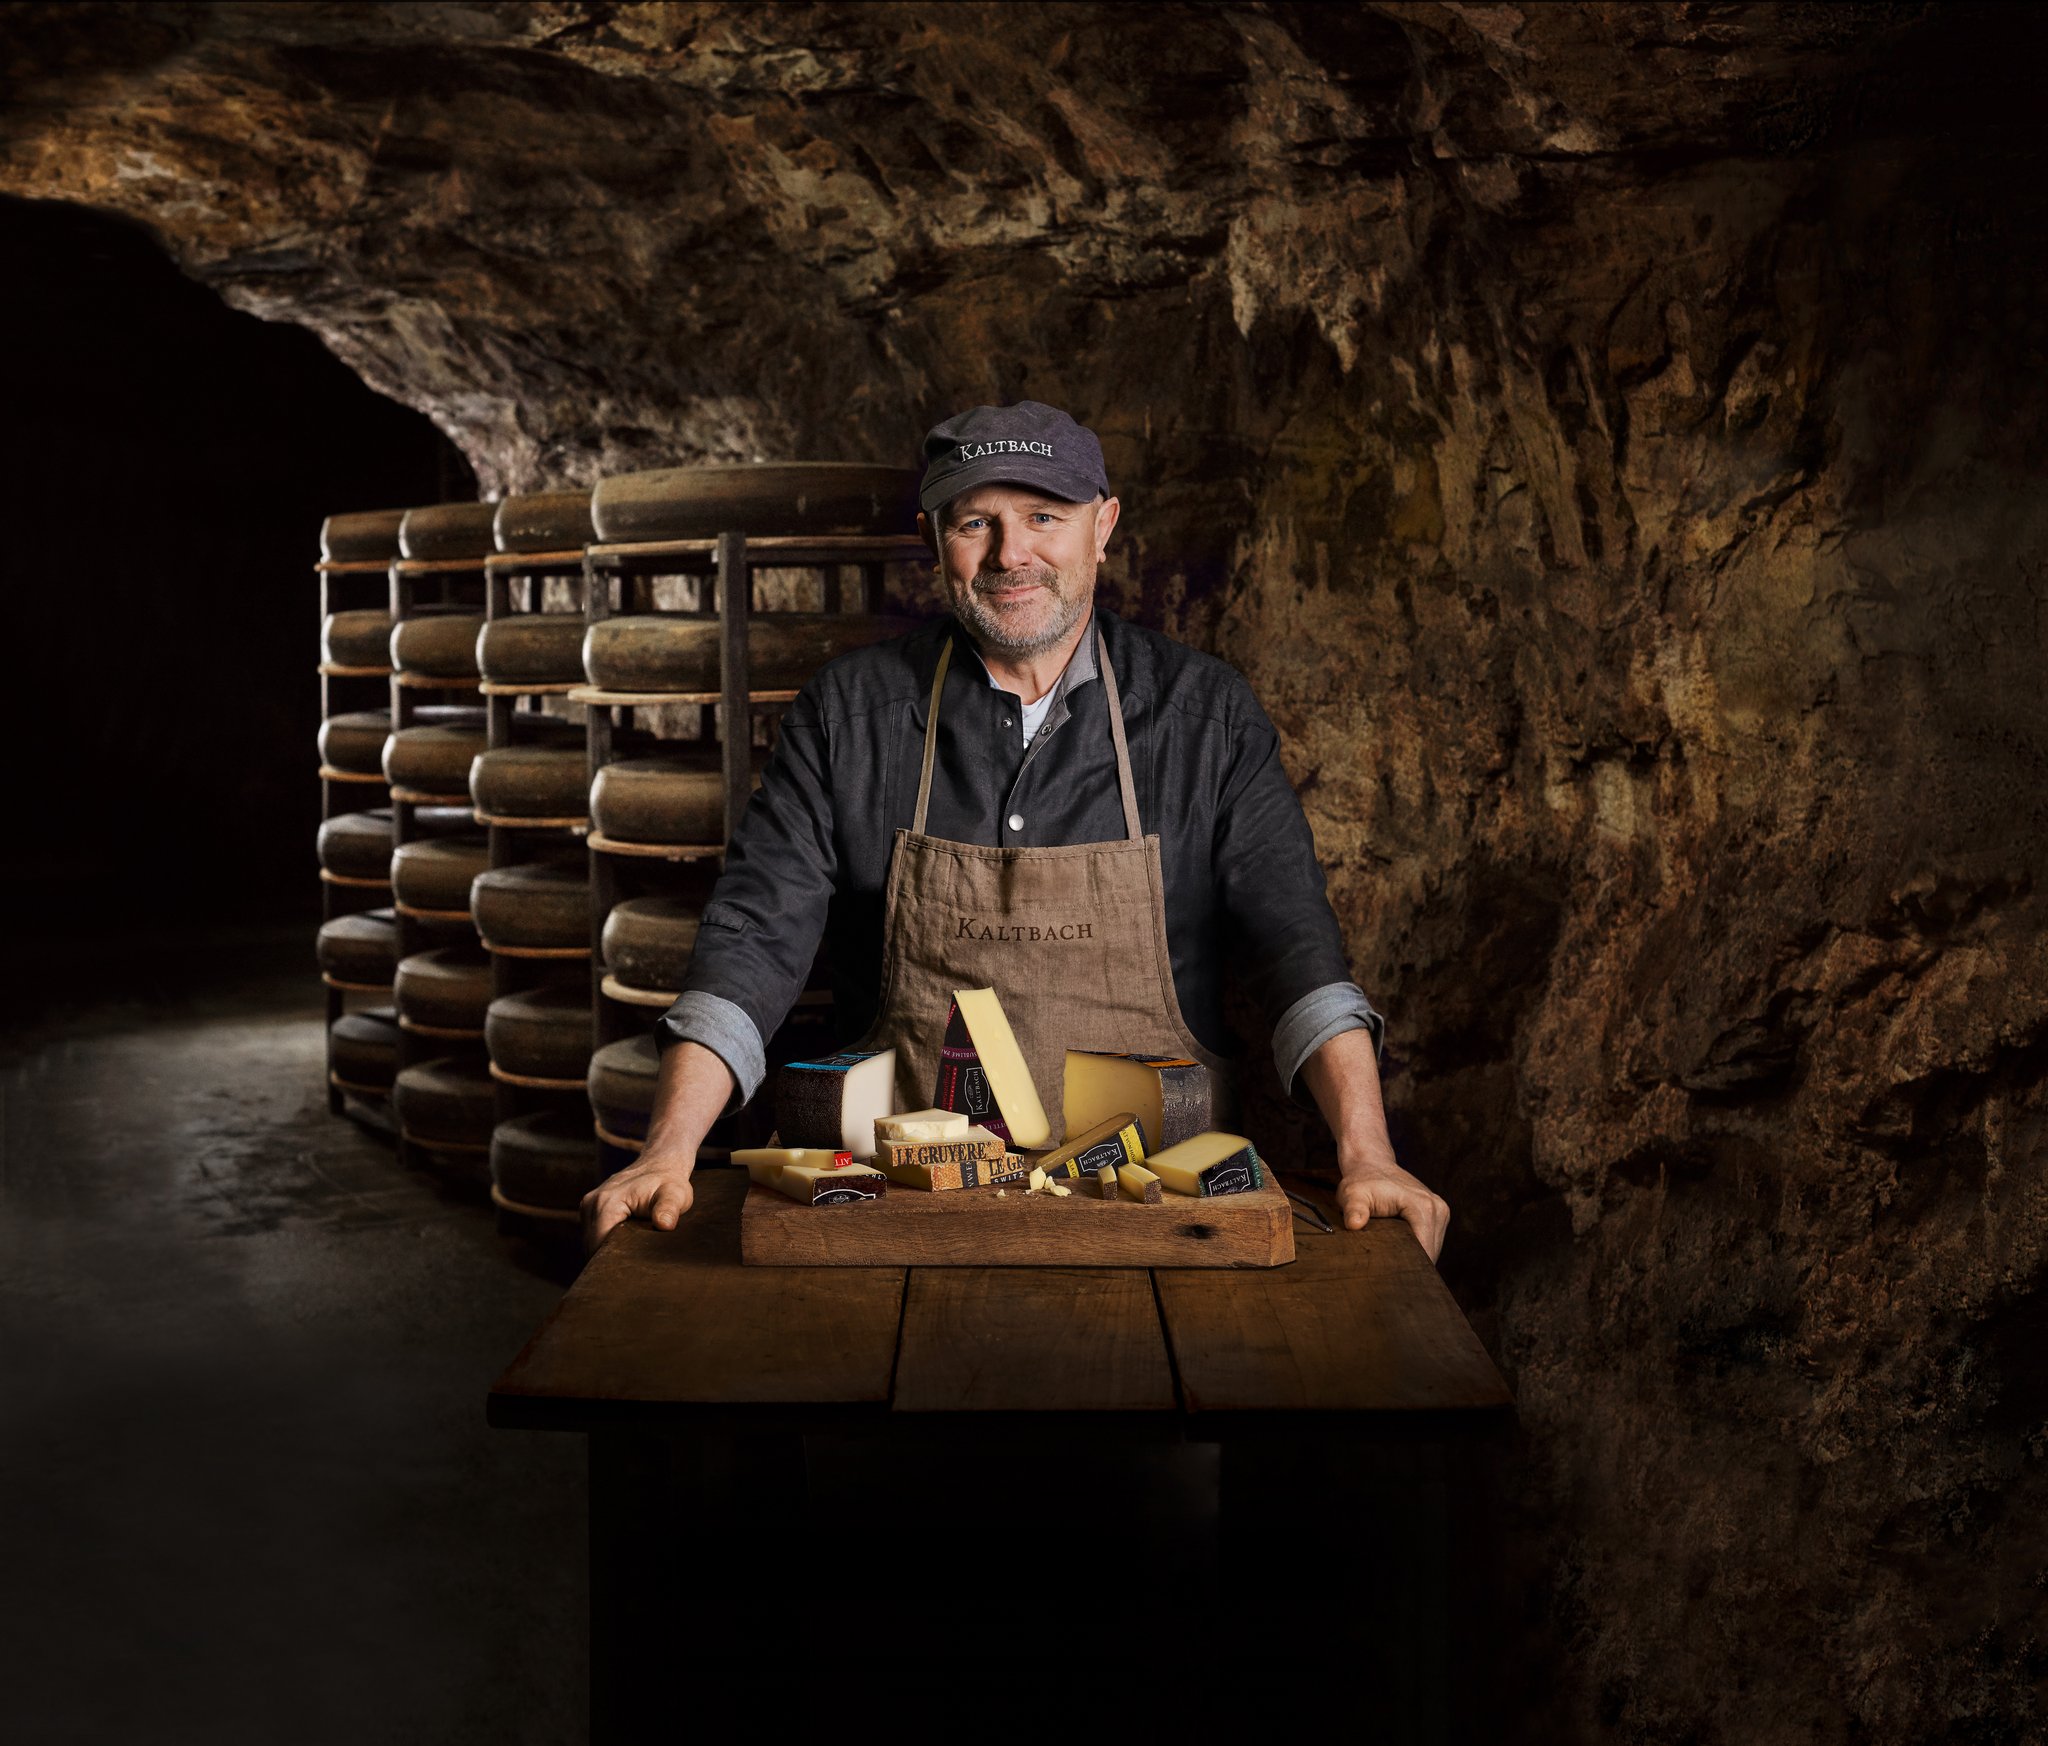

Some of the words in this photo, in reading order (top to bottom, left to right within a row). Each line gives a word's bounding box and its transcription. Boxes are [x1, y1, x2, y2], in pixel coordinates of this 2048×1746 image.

[960, 440, 1053, 463] KALTBACH
[956, 917, 1094, 942] KALTBACH
[973, 1070, 983, 1111] KALTBACH
[989, 1158, 1005, 1176] LE
[1083, 1148, 1119, 1165] KALTBACH
[1212, 1173, 1247, 1192] KALTBACH
